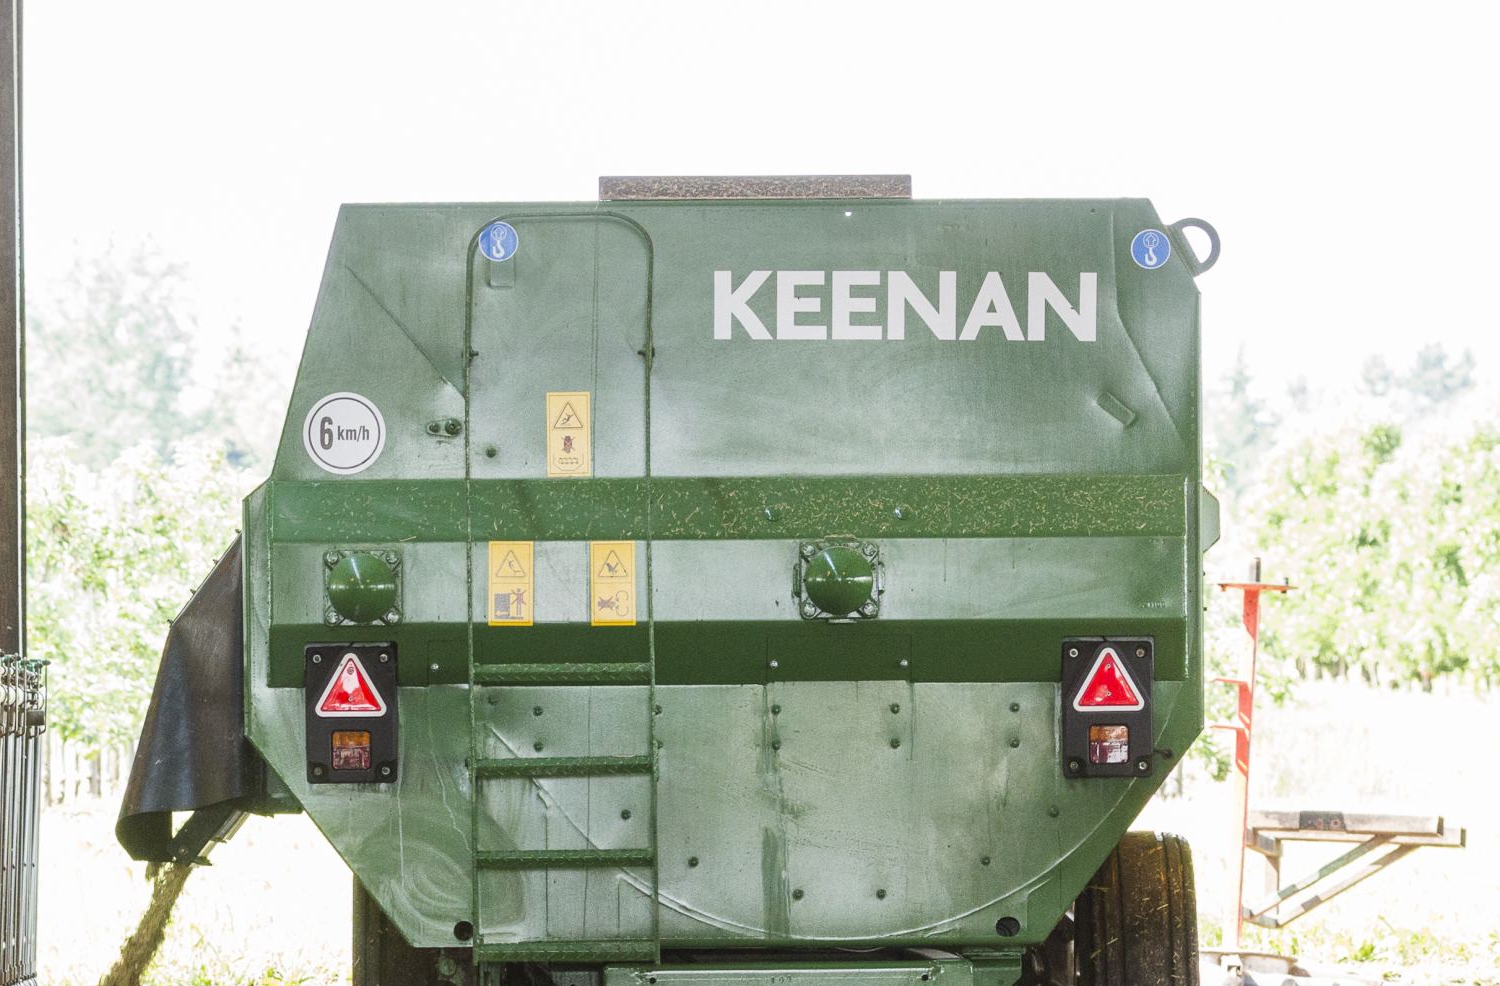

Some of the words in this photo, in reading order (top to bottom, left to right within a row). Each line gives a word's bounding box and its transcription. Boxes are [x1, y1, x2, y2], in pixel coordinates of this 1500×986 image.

[713, 270, 1098, 342] KEENAN
[320, 416, 334, 450] 6
[337, 425, 370, 443] km/h
